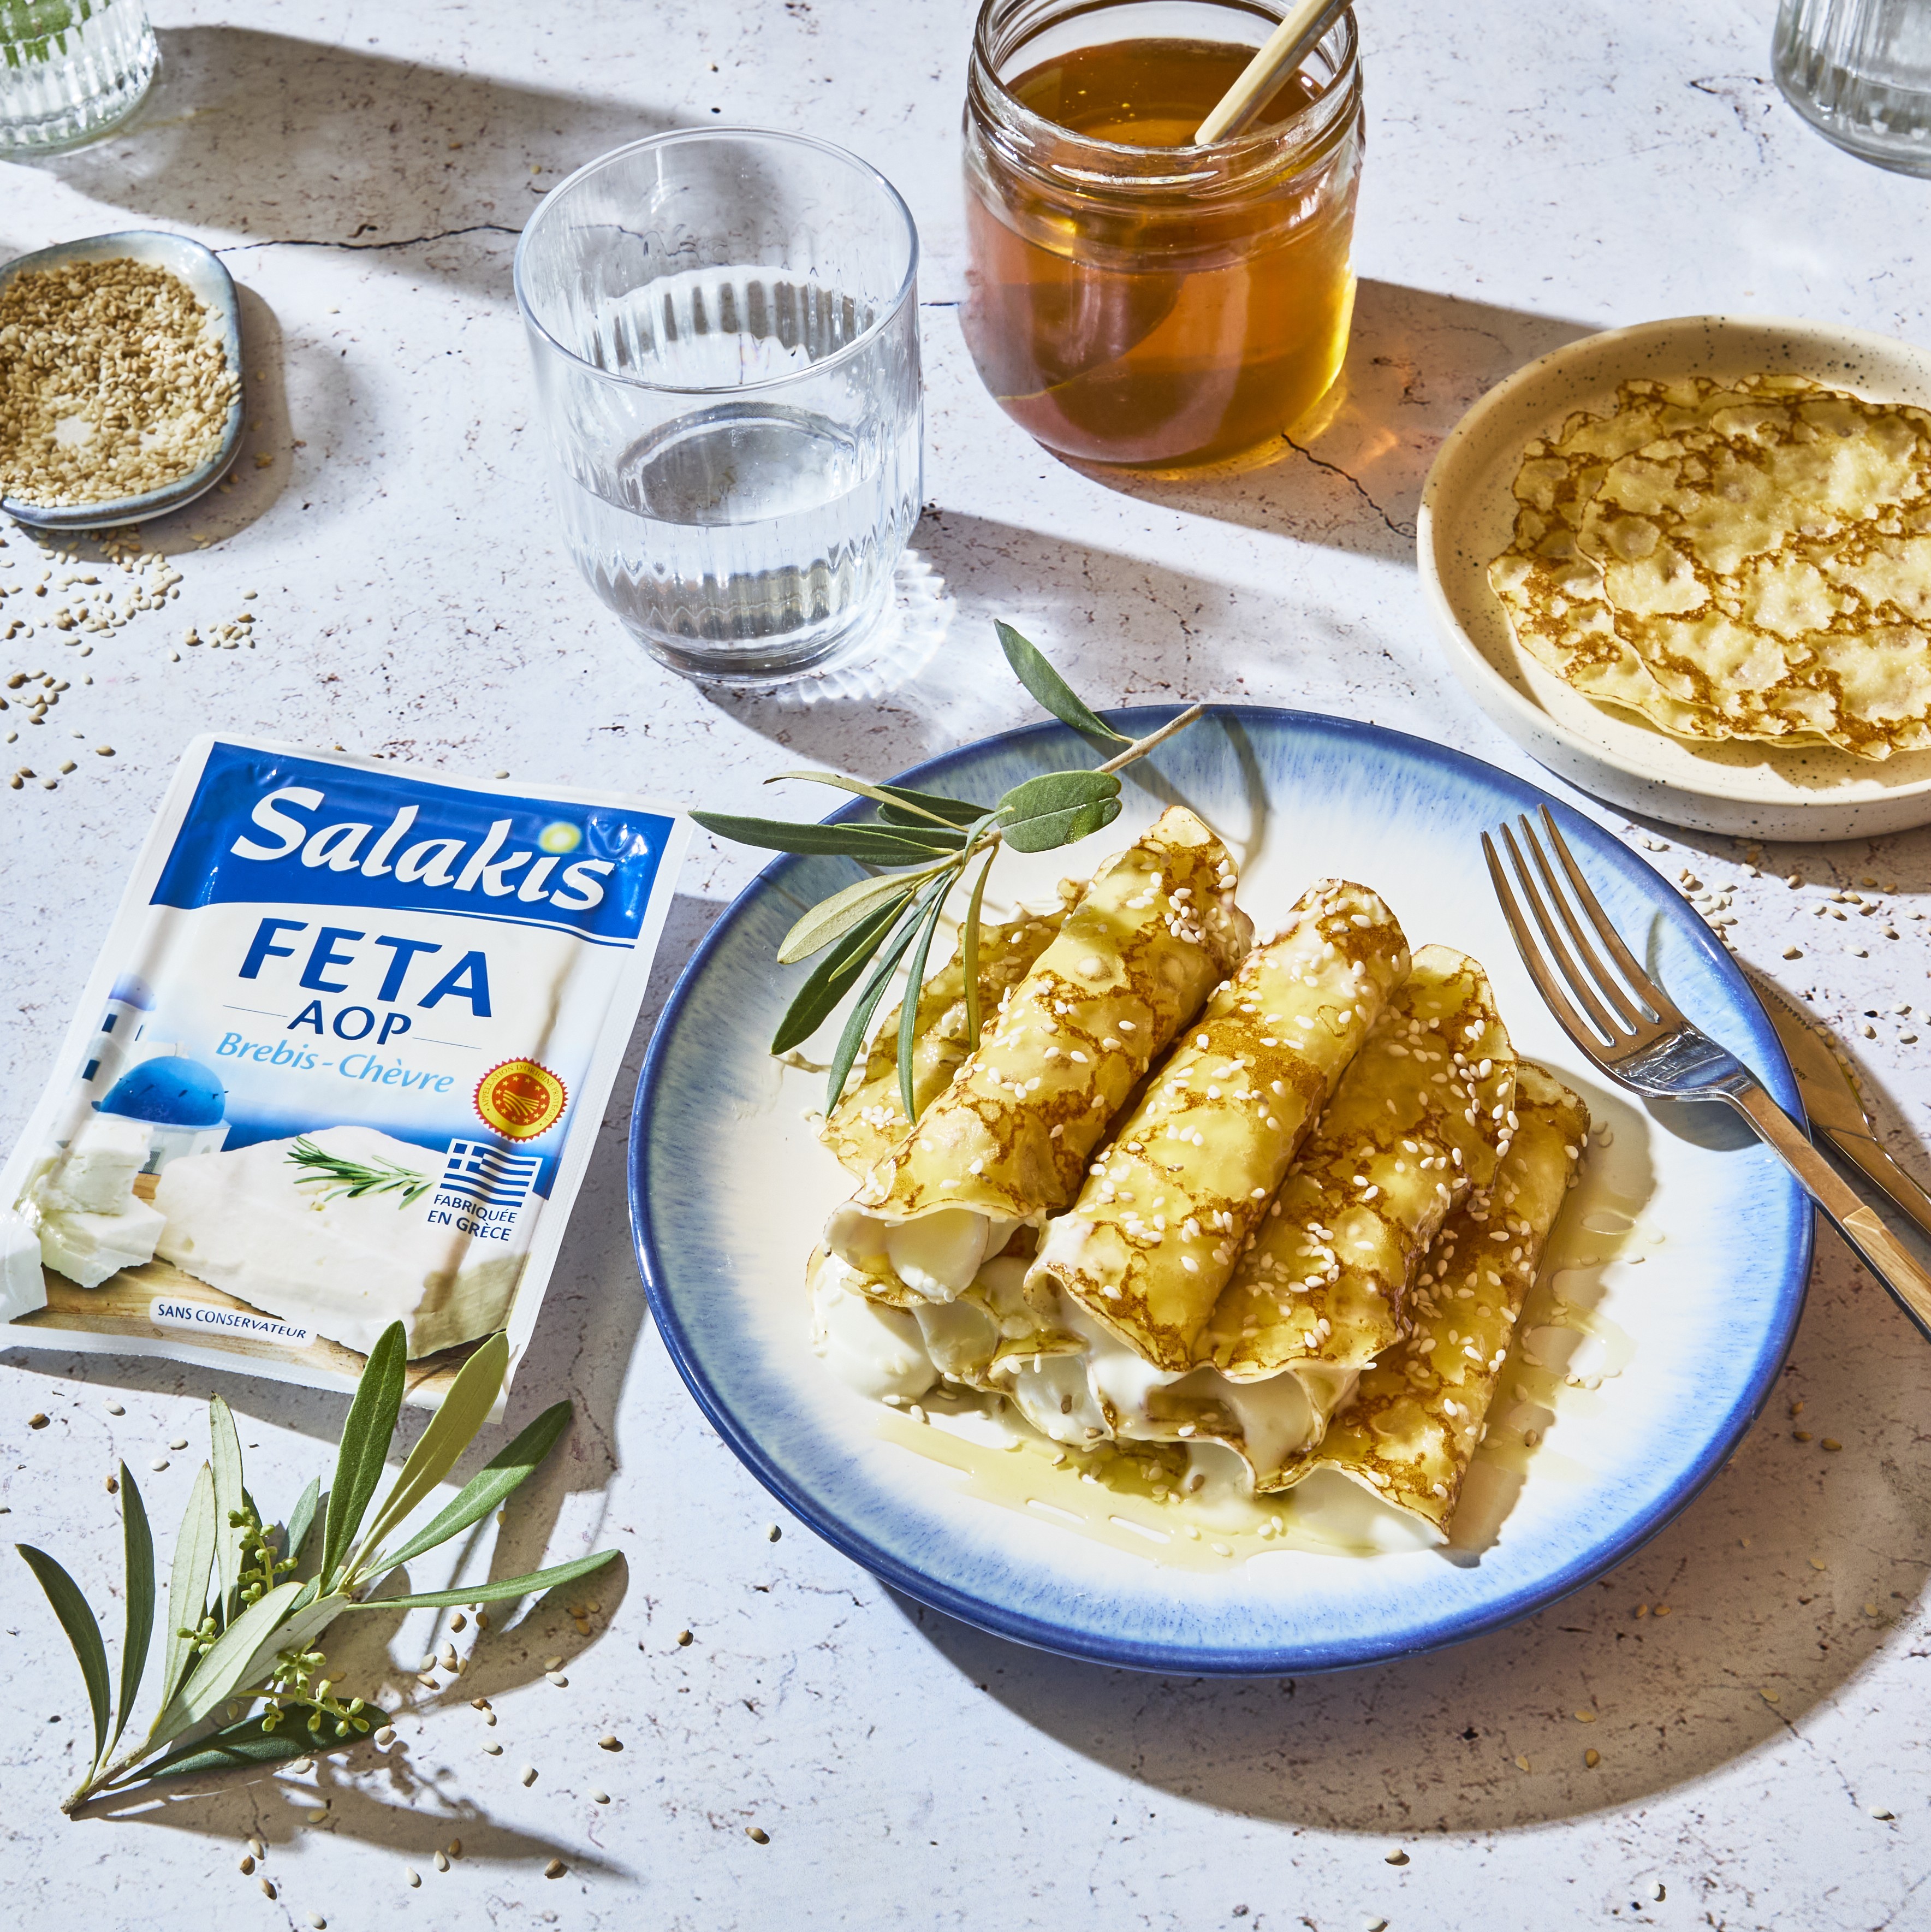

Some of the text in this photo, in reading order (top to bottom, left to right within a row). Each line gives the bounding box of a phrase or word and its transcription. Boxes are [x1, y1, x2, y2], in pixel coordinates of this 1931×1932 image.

[230, 786, 615, 910] Salakis
[238, 917, 492, 1017] FETA
[287, 1000, 412, 1045] AOP
[482, 1065, 514, 1107] APPELLATION
[516, 1064, 555, 1088] D'ORIGINE
[427, 1210, 512, 1241] EN GRÈCE
[433, 1194, 518, 1223] FABRIQUÉE
[157, 1304, 306, 1339] SANS CONSERVATEUR
